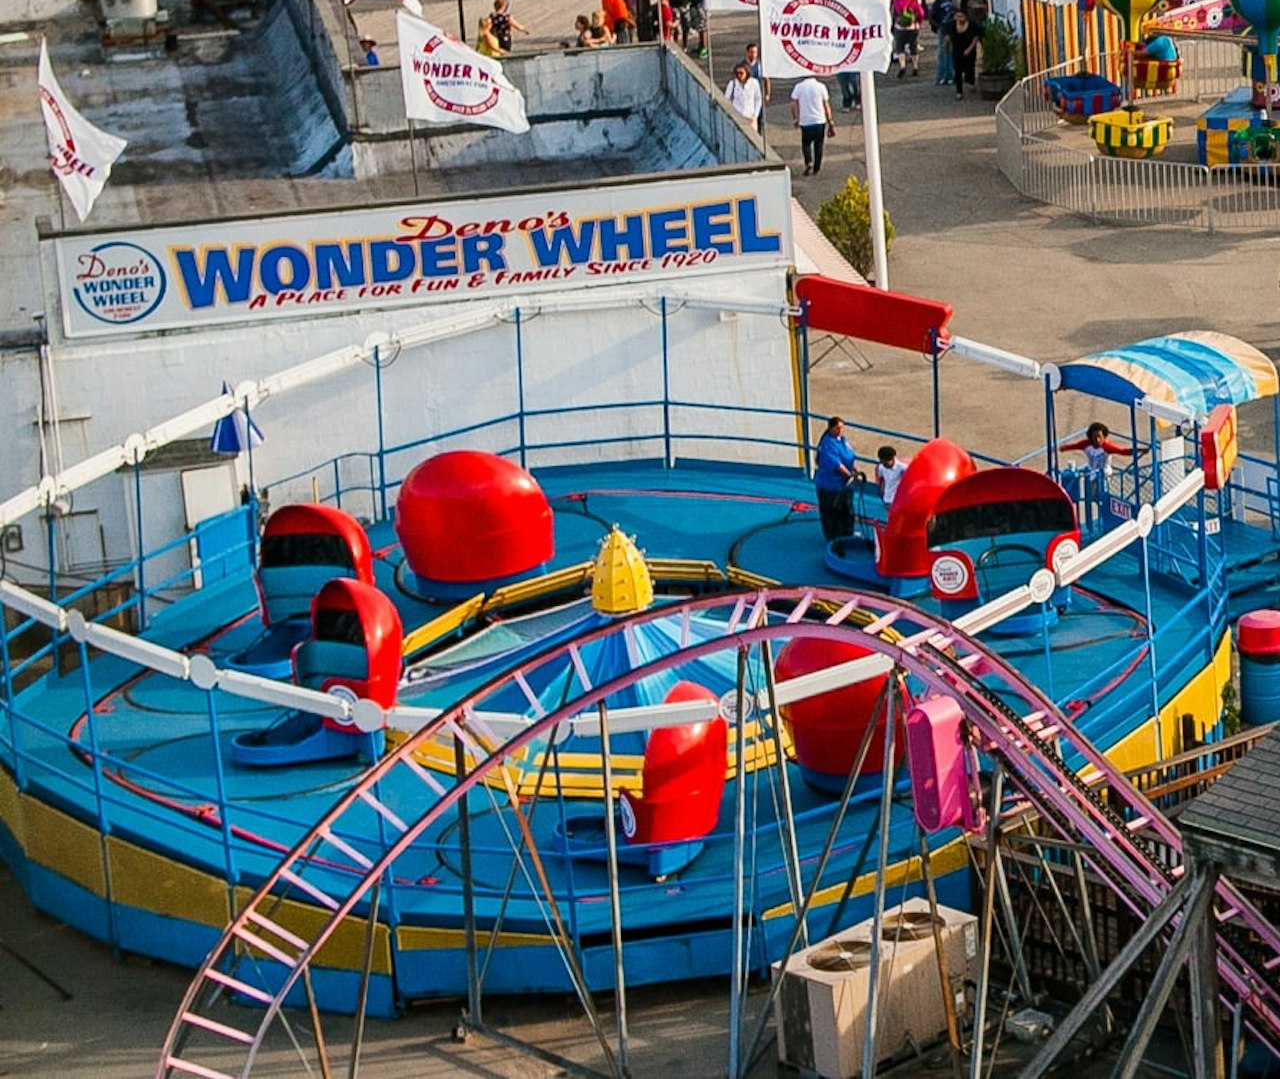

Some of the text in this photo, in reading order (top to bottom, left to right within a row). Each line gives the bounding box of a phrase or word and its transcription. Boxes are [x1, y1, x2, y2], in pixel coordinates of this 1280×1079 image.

[770, 21, 885, 41] WONDER WHEEL
[412, 60, 472, 80] WONDER
[396, 210, 570, 243] Deno's
[169, 194, 783, 311] WONDER WHEEL
[76, 254, 150, 281] Deno's
[83, 275, 155, 294] WONDER
[249, 249, 719, 310] A PLACE FOR FUN & FAMILY SINCE 1920
[92, 290, 150, 308] WHEEL
